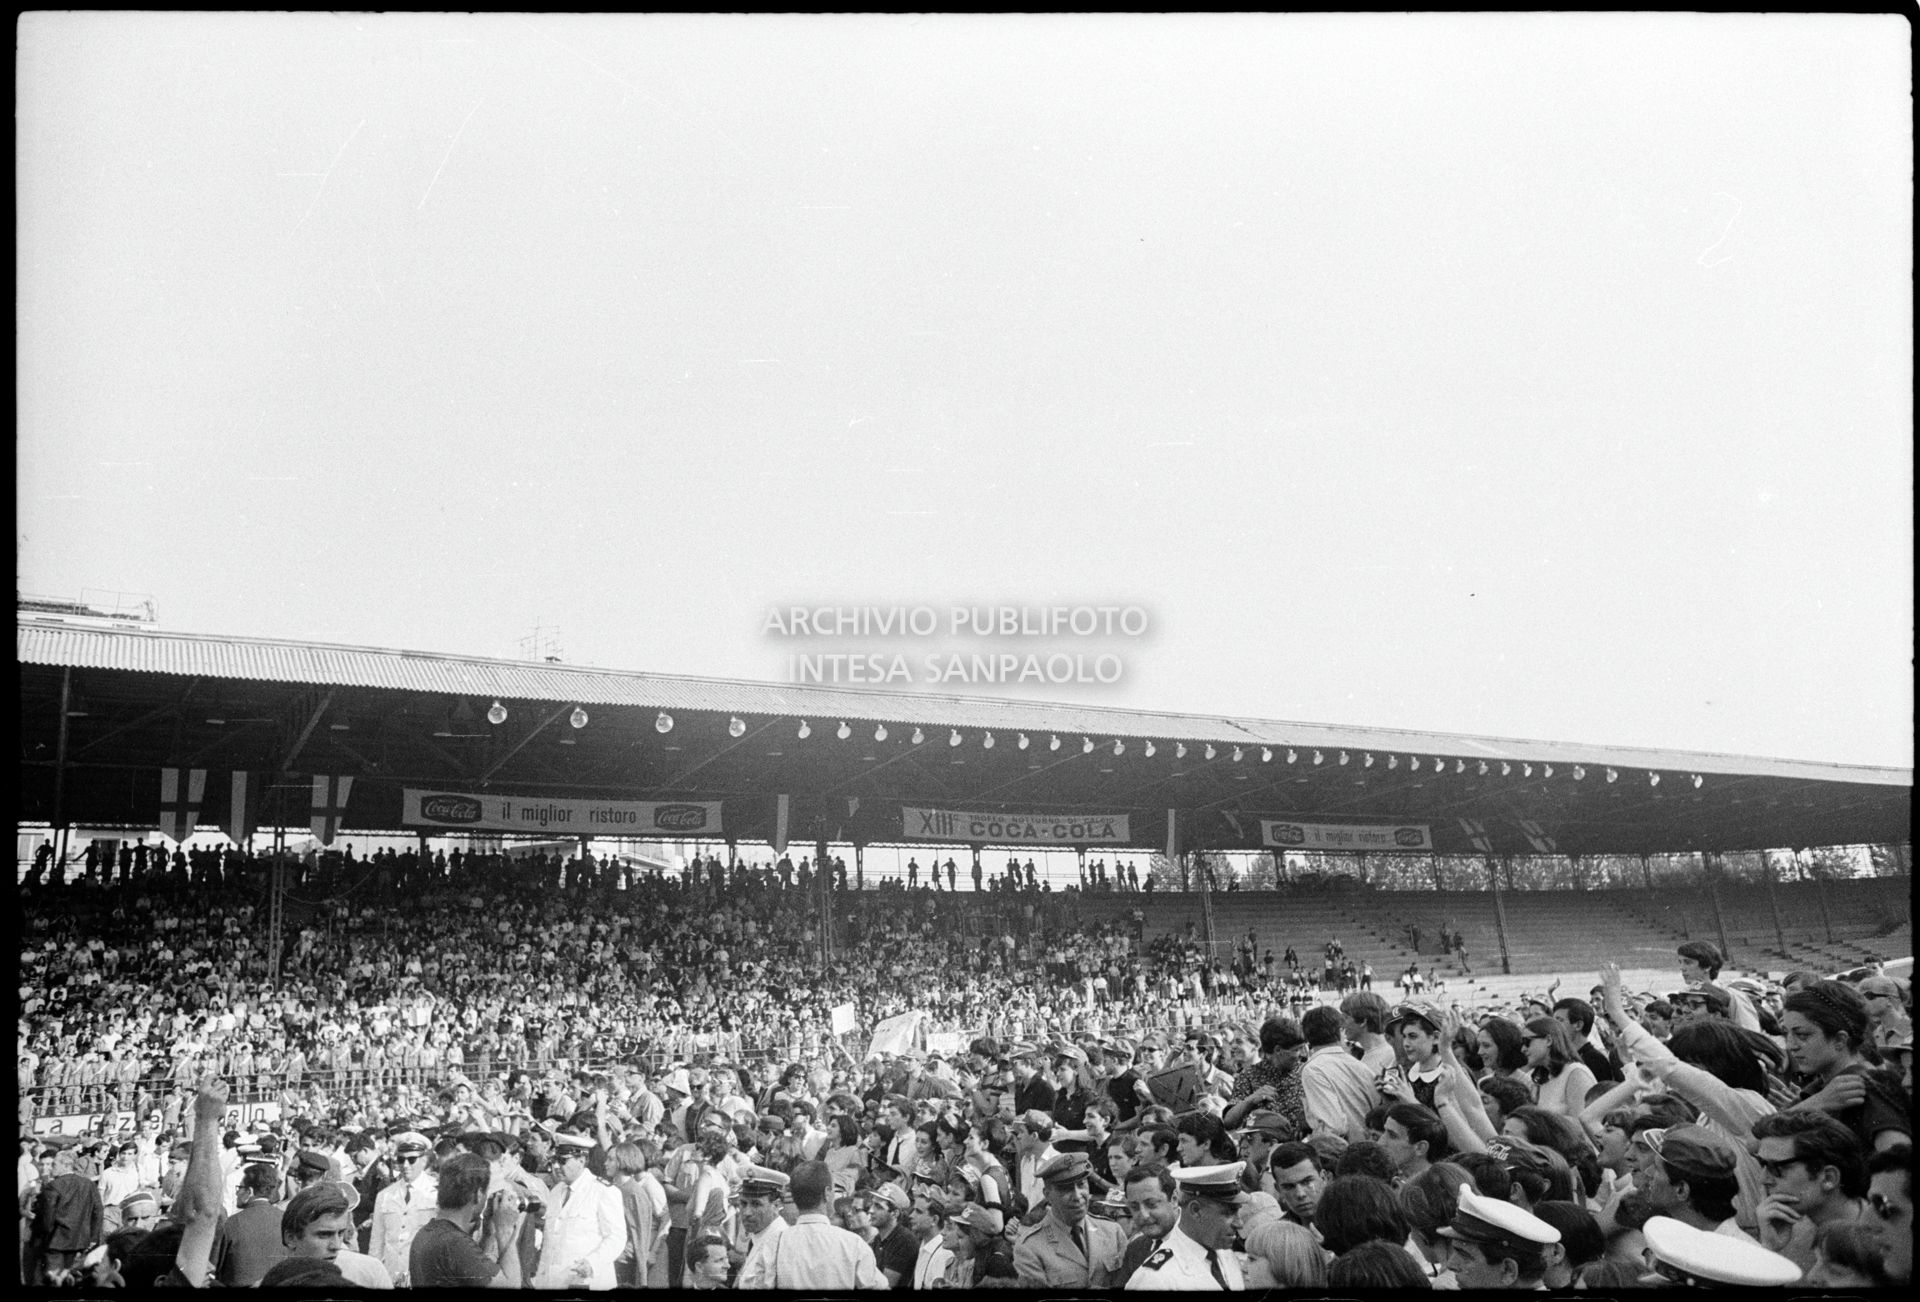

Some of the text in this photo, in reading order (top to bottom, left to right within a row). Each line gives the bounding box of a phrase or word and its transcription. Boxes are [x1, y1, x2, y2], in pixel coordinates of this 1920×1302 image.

[502, 803, 637, 826] il miglior ristoro
[970, 821, 1117, 839] COCA-COLA
